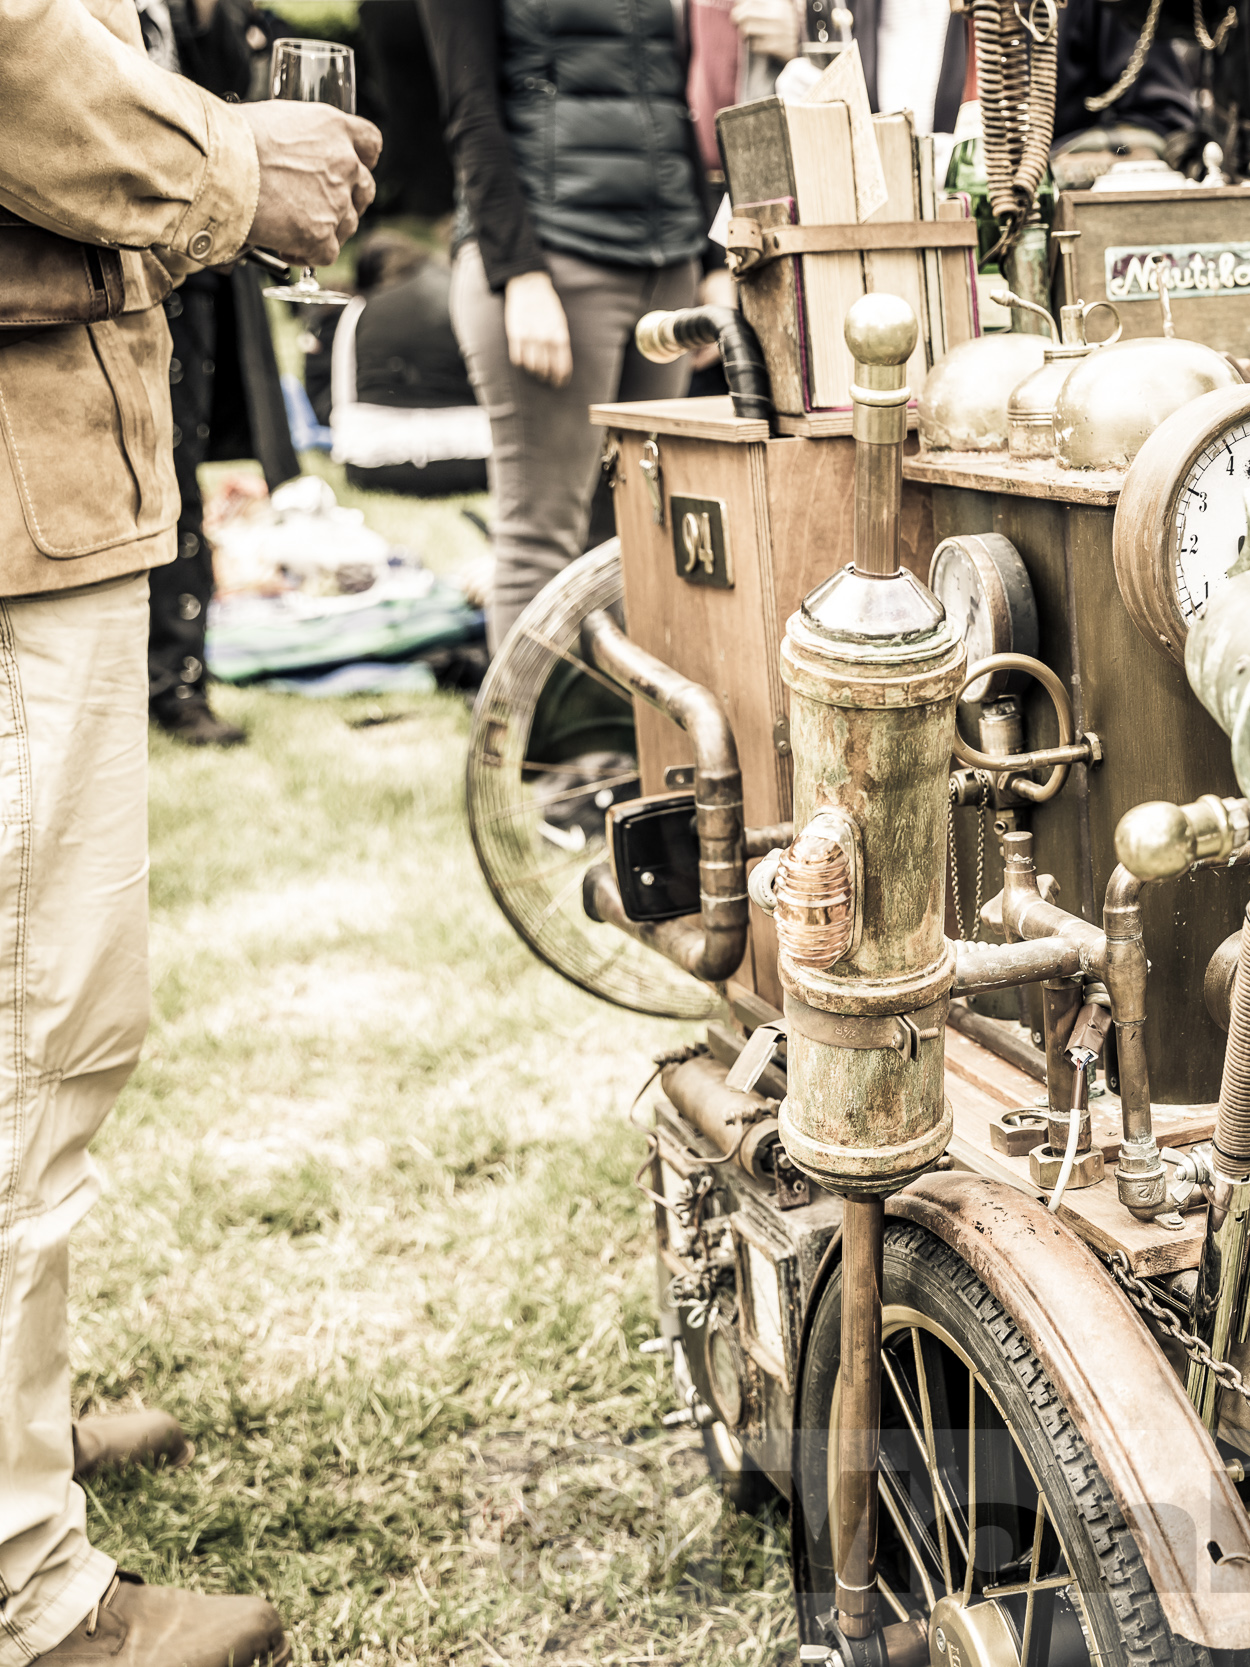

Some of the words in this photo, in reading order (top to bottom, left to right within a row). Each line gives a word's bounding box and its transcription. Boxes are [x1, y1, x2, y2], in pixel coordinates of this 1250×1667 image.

[1225, 455, 1235, 476] 4
[1198, 491, 1208, 513] 3
[682, 512, 714, 574] 94
[1189, 534, 1199, 555] 2
[1203, 581, 1210, 600] 1
